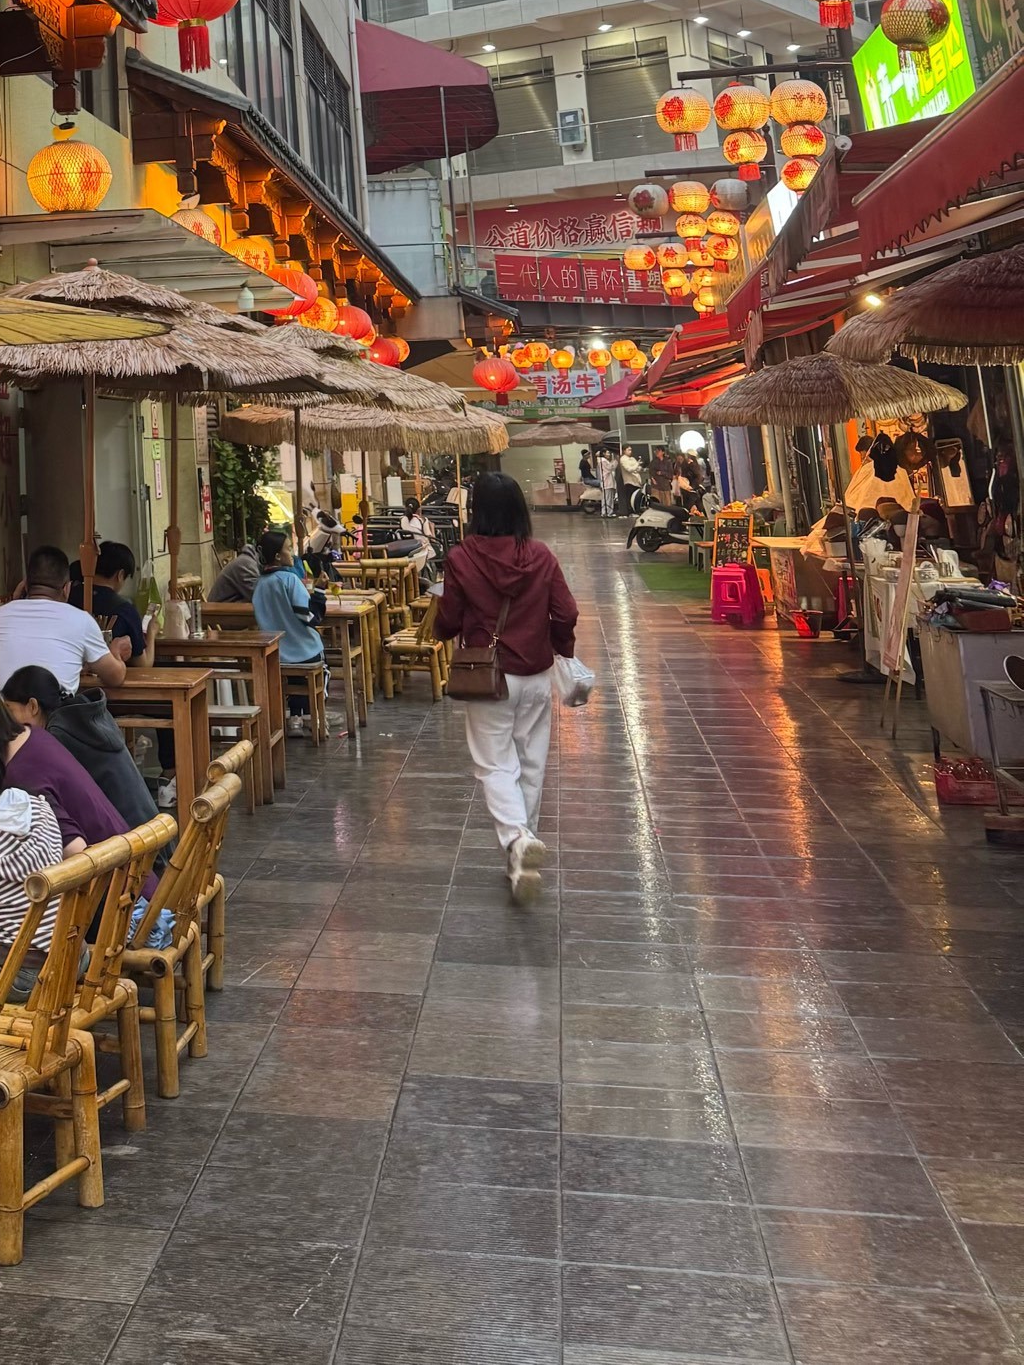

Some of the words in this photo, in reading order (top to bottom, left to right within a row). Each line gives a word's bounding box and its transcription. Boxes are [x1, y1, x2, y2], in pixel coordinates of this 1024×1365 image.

[498, 264, 619, 291] 三代人的情怀
[528, 373, 607, 396] 清汤牛
